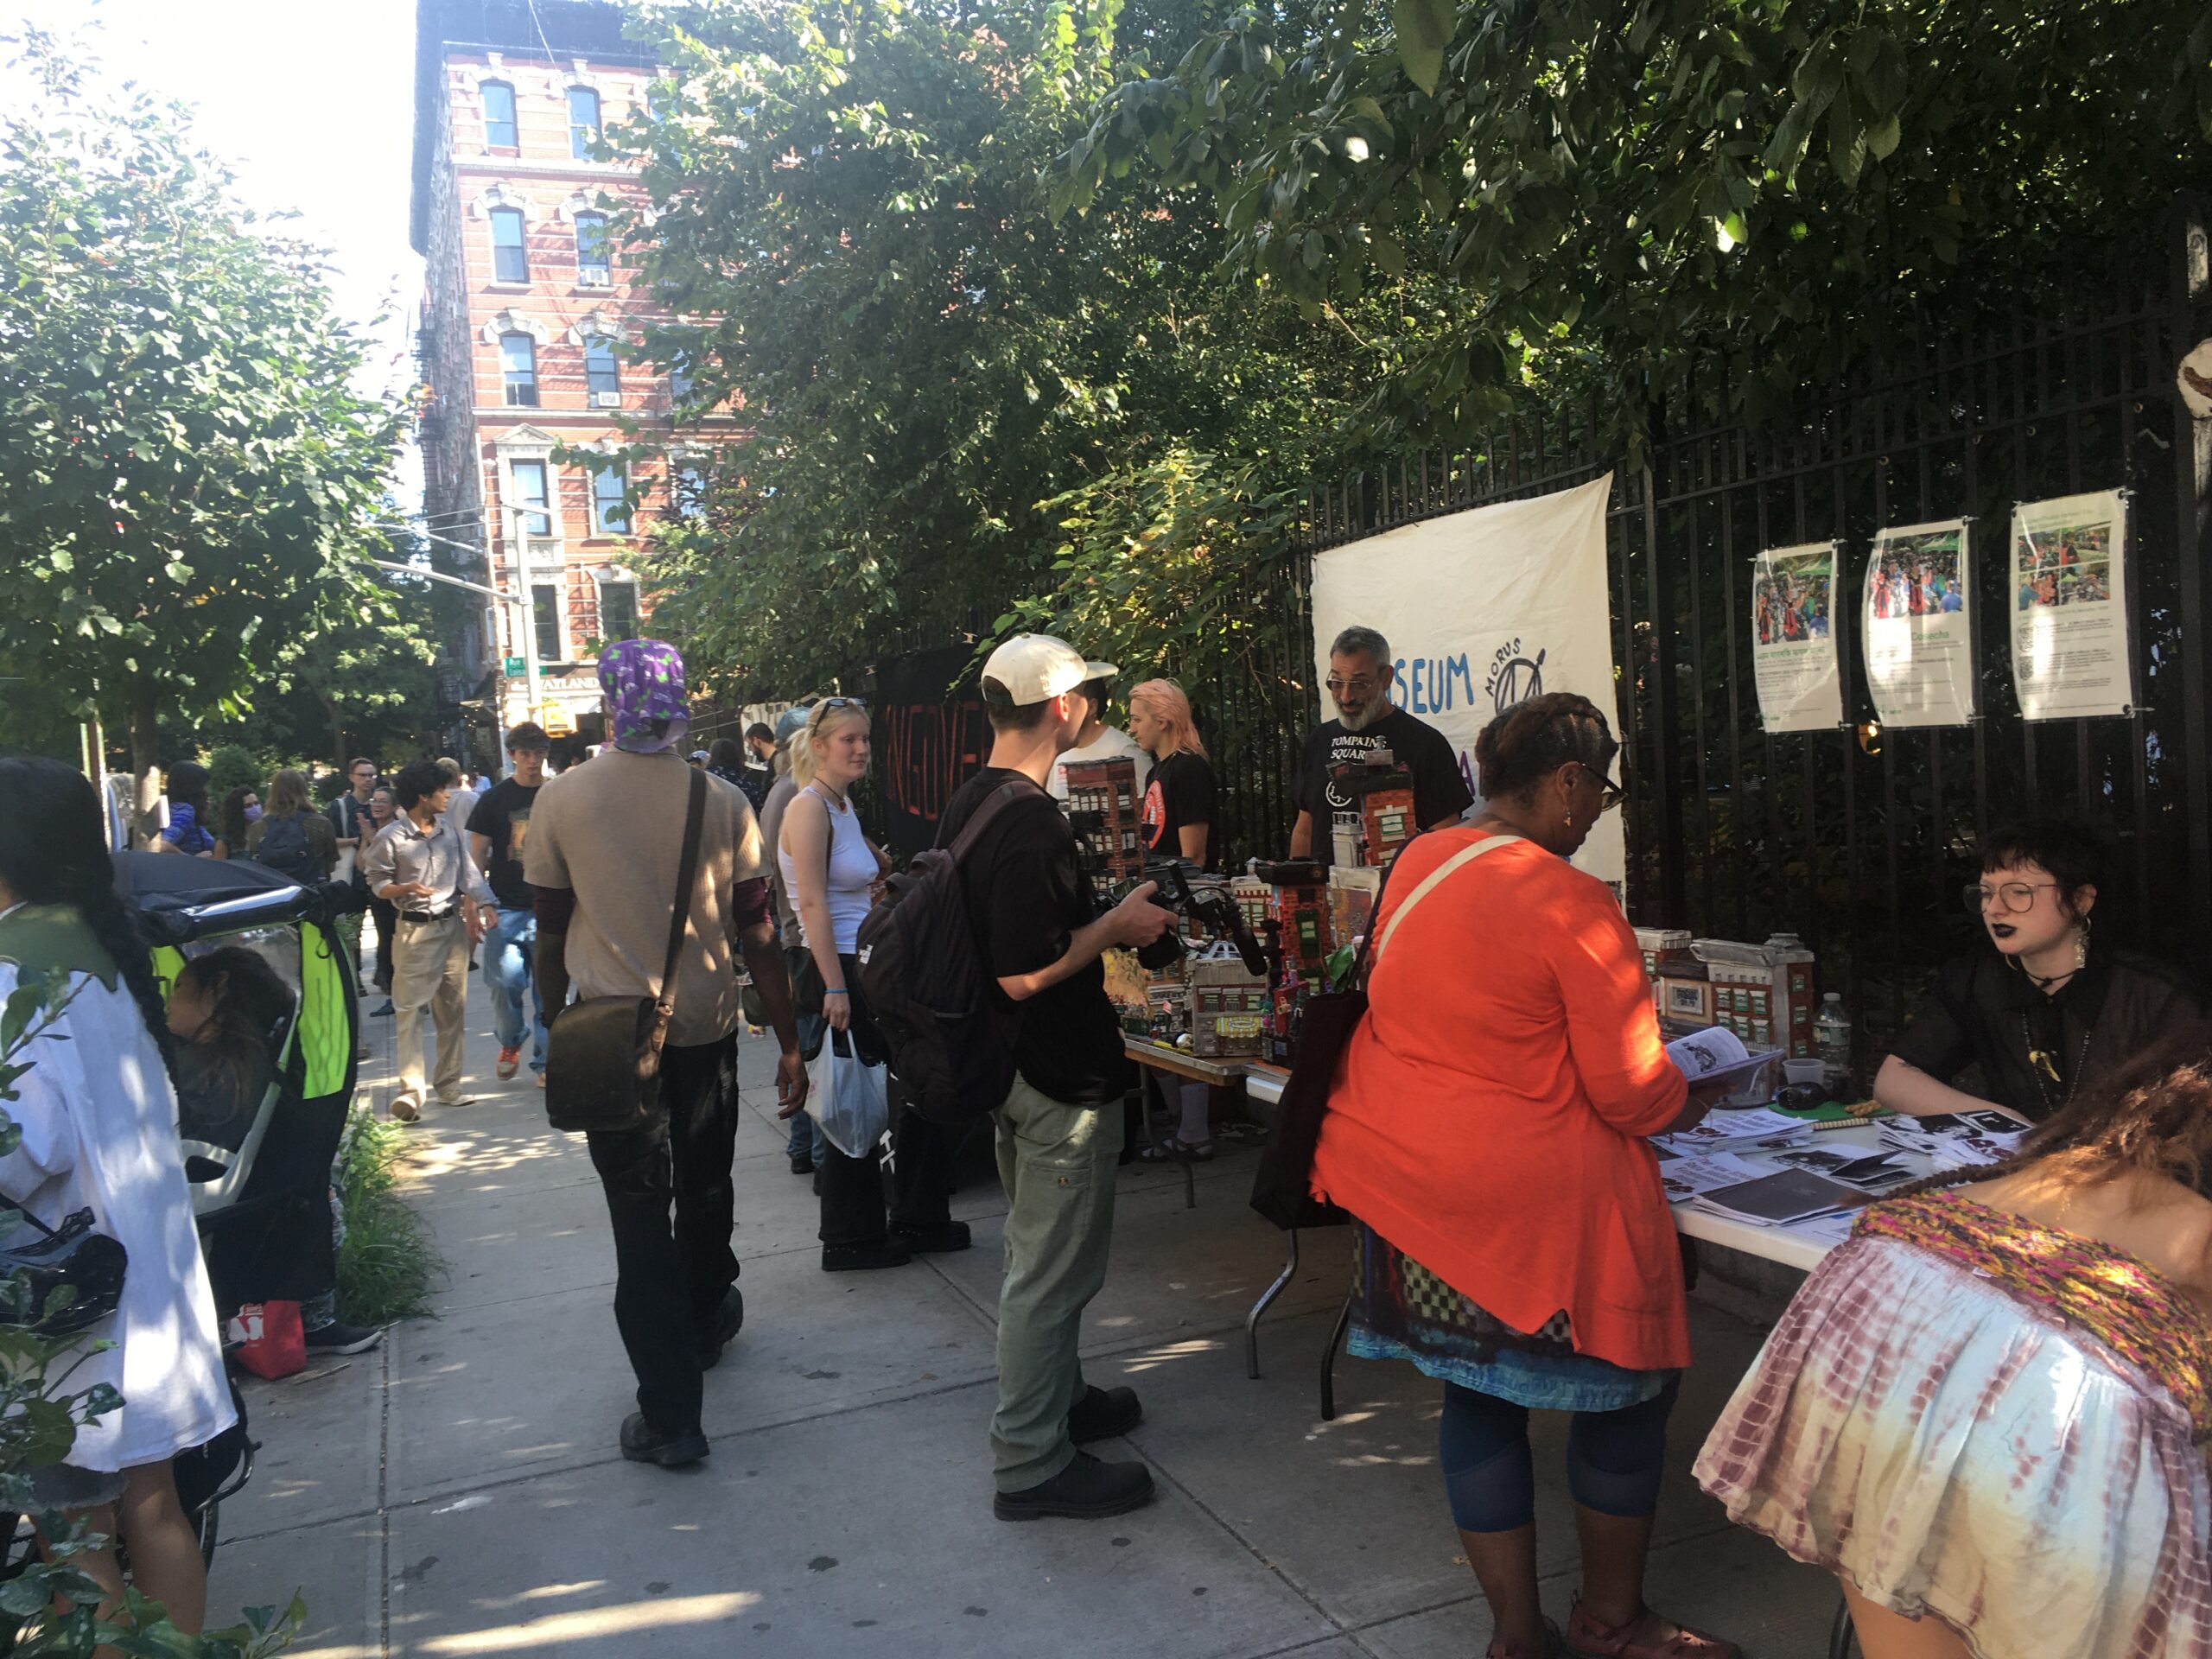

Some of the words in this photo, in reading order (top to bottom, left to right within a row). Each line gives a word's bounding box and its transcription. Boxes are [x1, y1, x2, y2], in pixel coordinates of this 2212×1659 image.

[1386, 652, 1475, 715] SEUM
[1484, 637, 1522, 698] MORUS
[1330, 734, 1387, 749] TOMPKIN
[1330, 748, 1366, 760] SQUAR
